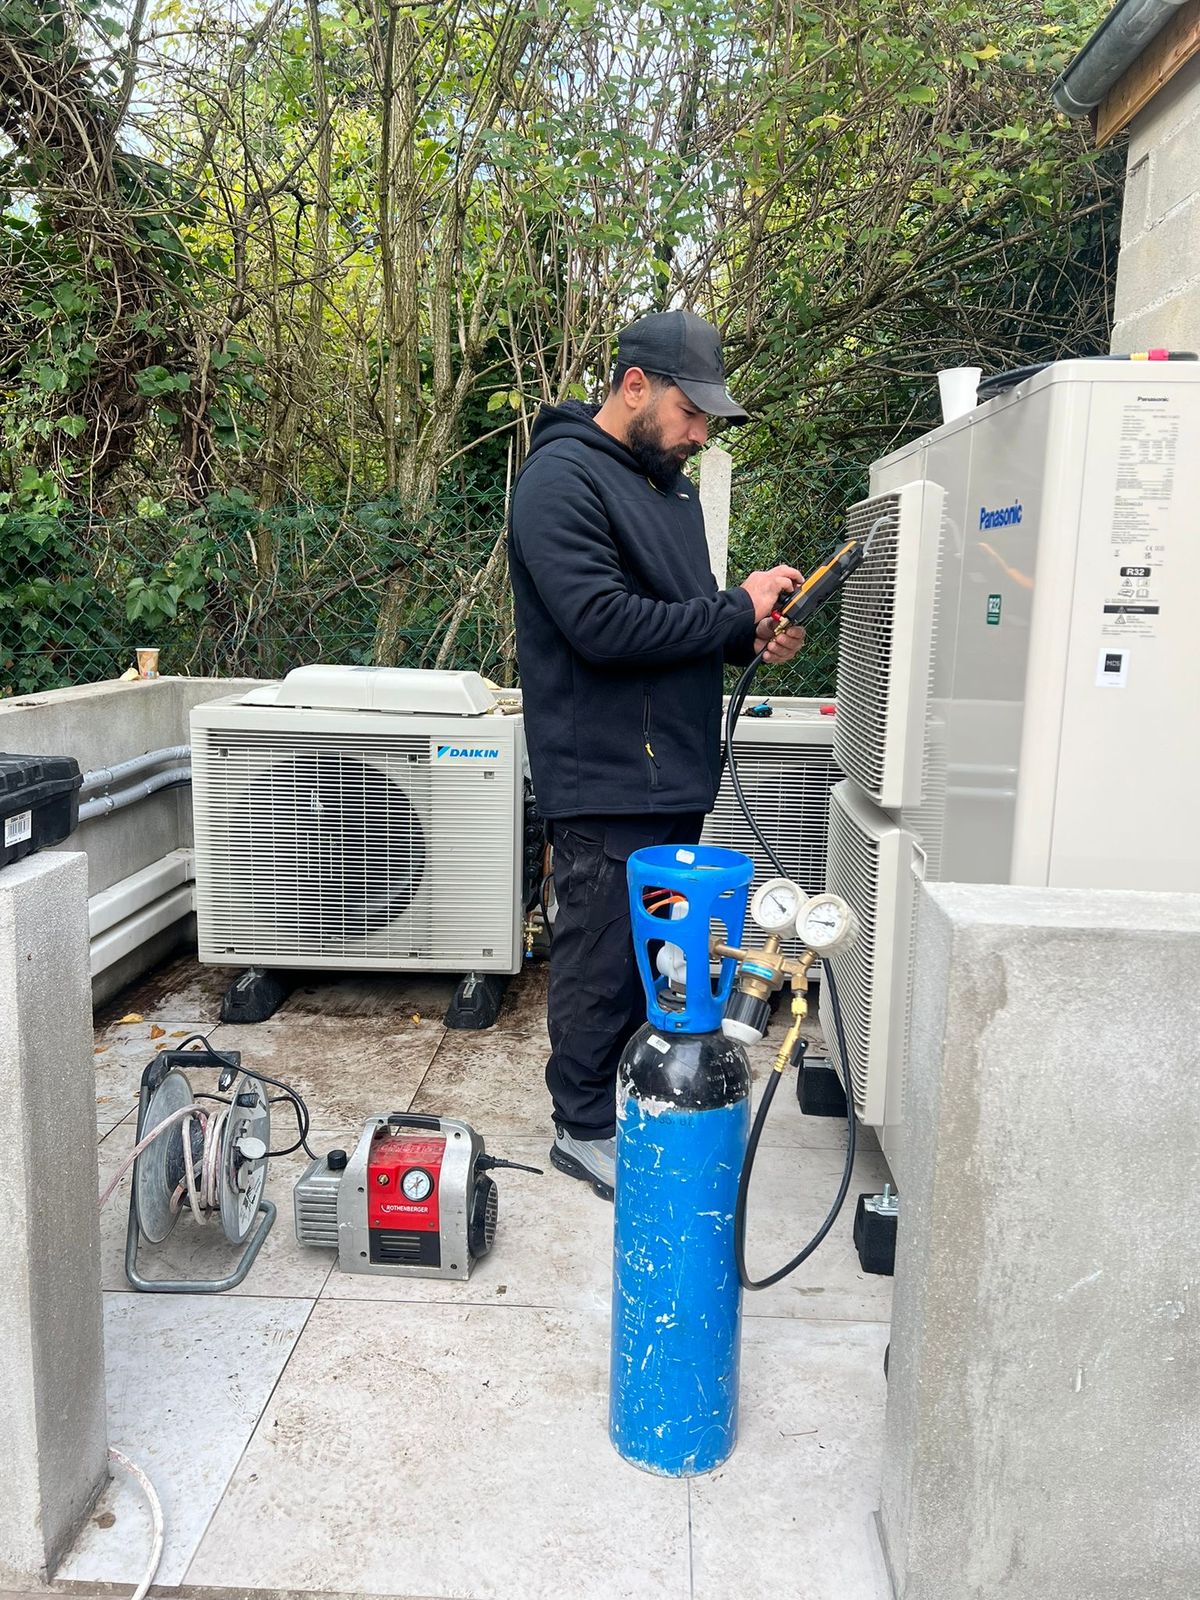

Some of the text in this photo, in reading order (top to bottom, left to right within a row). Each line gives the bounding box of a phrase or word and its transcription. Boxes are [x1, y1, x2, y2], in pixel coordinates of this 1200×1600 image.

[979, 498, 1022, 531] Panasonic
[1126, 568, 1145, 576] R32
[989, 597, 1000, 612] R32
[449, 748, 499, 758] DAIKIN
[381, 1204, 428, 1213] ROTHENBERGER
